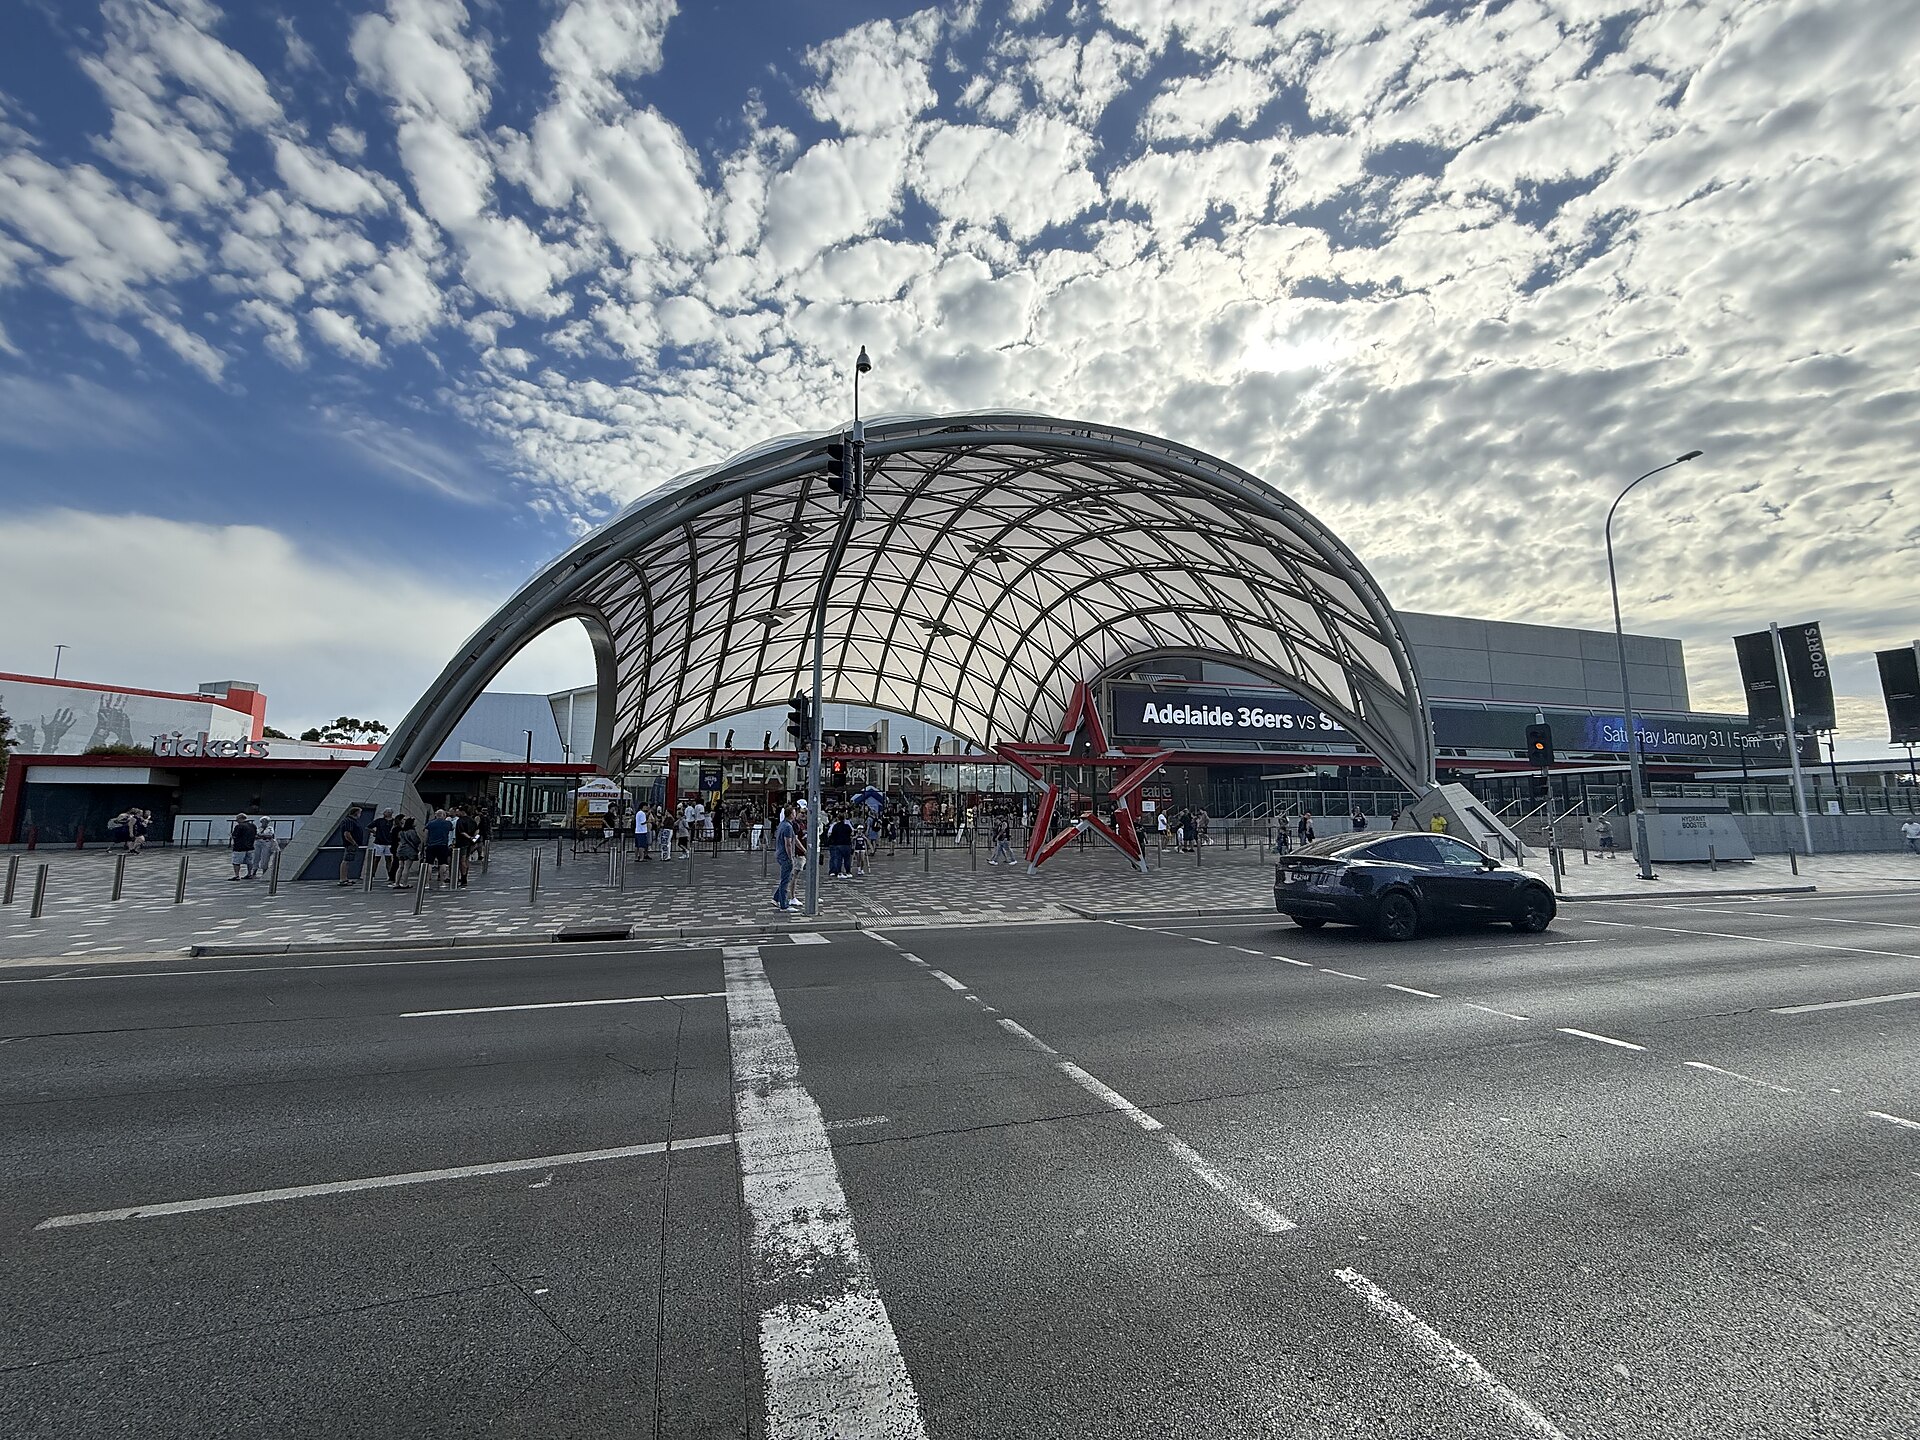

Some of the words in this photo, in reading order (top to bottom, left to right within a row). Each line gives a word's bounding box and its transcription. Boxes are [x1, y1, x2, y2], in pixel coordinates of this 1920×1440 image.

[1804, 628, 1826, 678] SPORTS
[1142, 702, 1233, 727] Adelaide
[1237, 707, 1293, 729] 36ers
[153, 731, 269, 758] tickets
[1603, 725, 1658, 748] Satday
[1662, 728, 1708, 750] January
[1711, 730, 1725, 747] 31
[1733, 731, 1760, 750] 5pm
